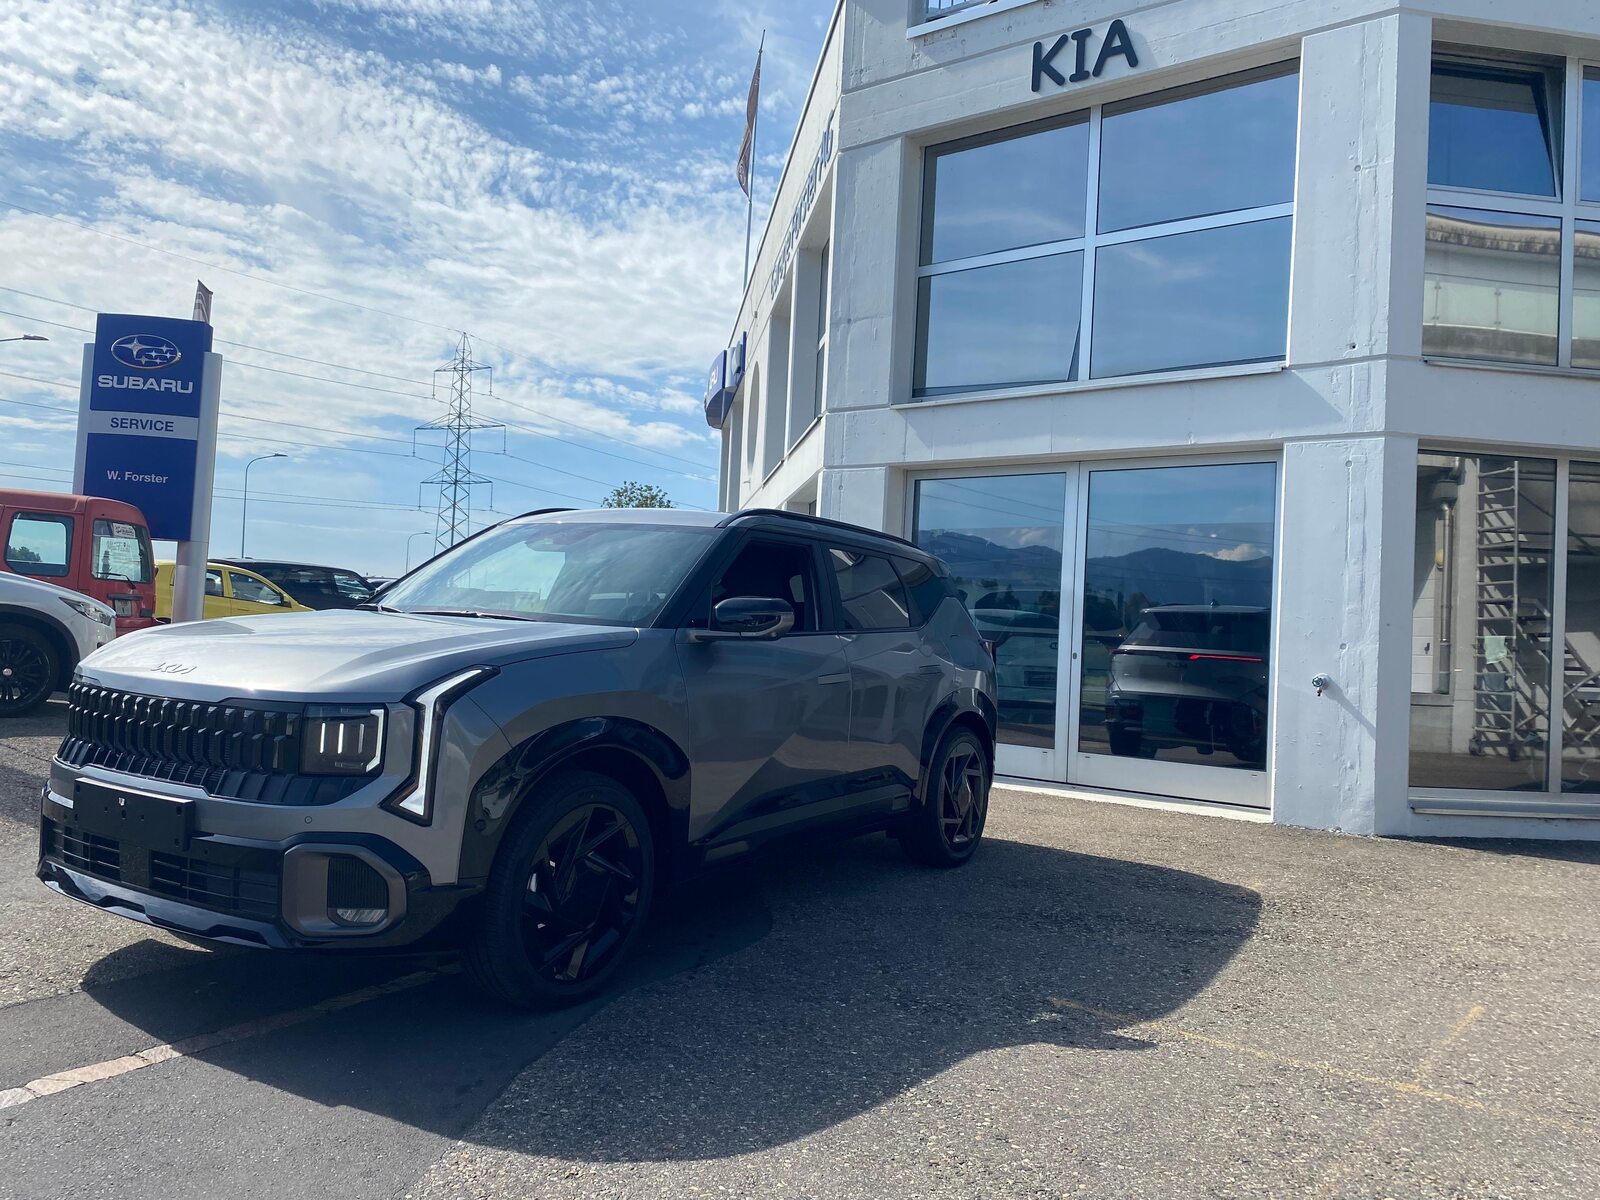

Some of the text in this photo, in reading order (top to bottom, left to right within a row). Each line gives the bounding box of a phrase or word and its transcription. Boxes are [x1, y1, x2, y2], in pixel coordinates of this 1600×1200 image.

[1031, 19, 1138, 92] KIA
[98, 374, 193, 394] SUBARU
[110, 417, 174, 432] SERVICE
[107, 470, 169, 484] W. Forster
